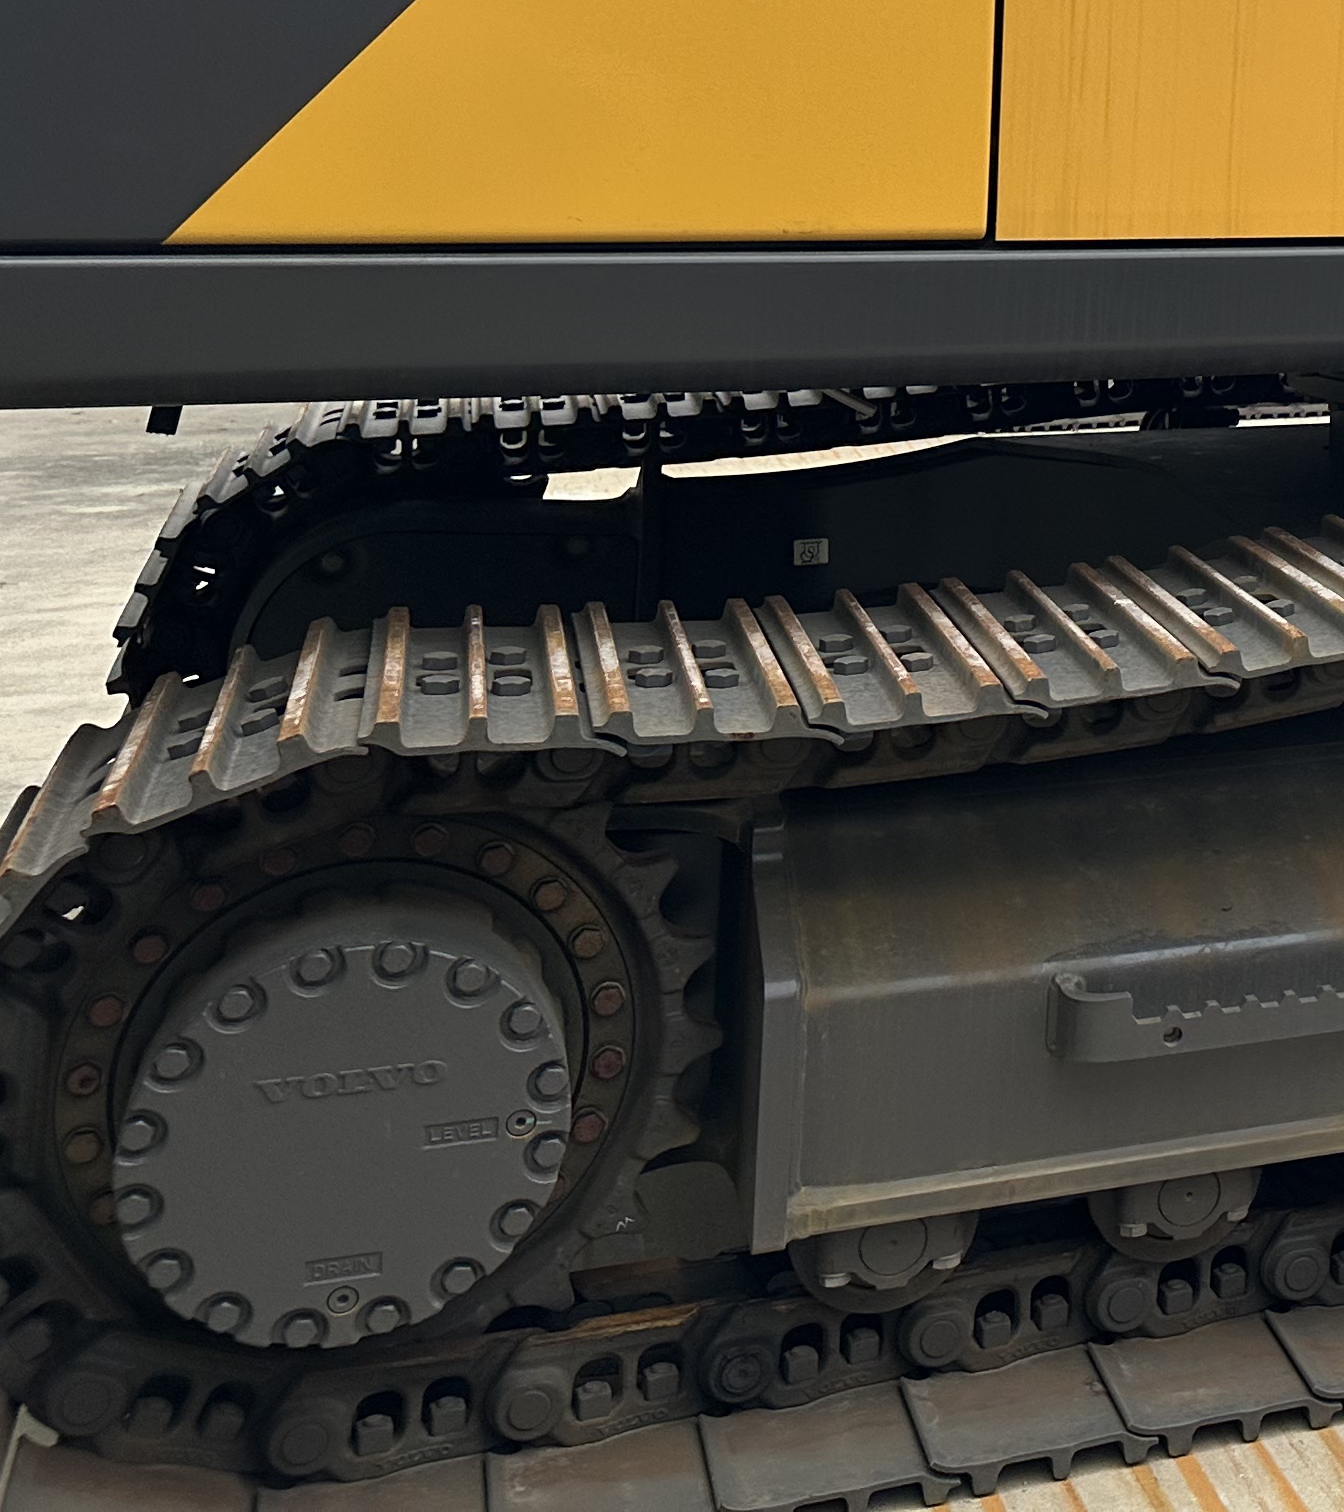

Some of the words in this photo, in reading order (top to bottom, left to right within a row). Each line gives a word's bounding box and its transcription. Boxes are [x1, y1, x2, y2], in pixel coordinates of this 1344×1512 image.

[252, 1060, 449, 1103] VOLVO
[429, 1121, 494, 1142] LEVEL
[311, 1255, 378, 1279] DRAIN
